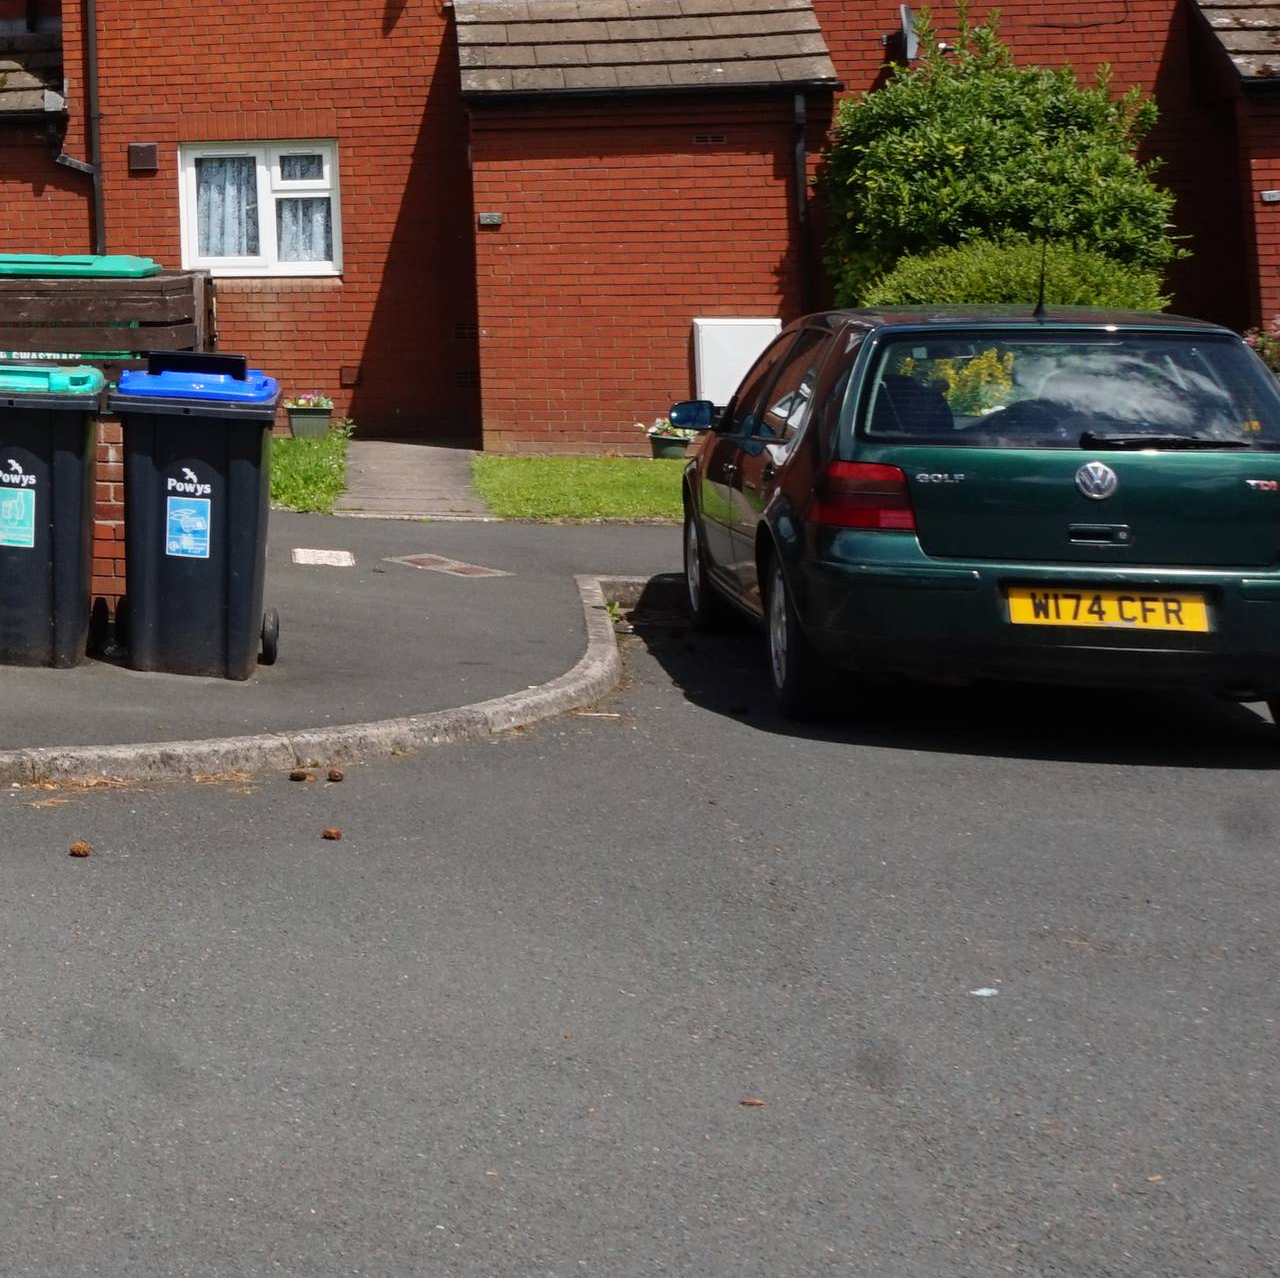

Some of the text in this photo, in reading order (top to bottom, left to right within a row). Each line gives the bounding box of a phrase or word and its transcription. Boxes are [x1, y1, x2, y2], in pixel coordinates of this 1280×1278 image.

[167, 477, 212, 496] Powys
[915, 473, 965, 483] GOLF
[1030, 592, 1184, 625] W174 CFR
